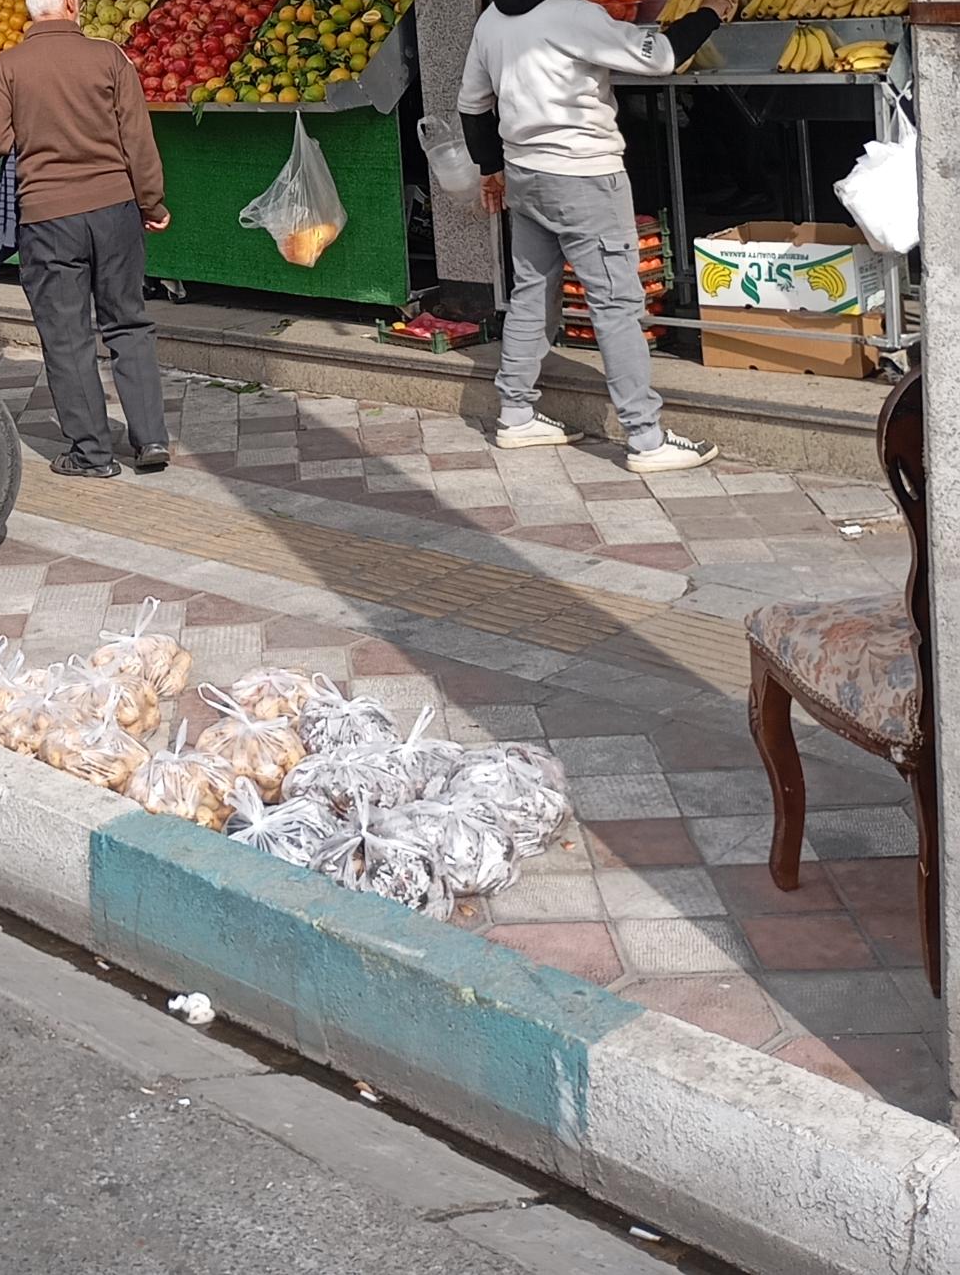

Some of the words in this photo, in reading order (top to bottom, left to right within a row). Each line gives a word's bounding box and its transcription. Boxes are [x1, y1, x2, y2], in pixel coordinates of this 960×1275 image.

[720, 250, 746, 259] BANANA
[748, 251, 777, 260] QUALITY
[777, 252, 810, 261] PREMIUM
[748, 260, 793, 284] STC
